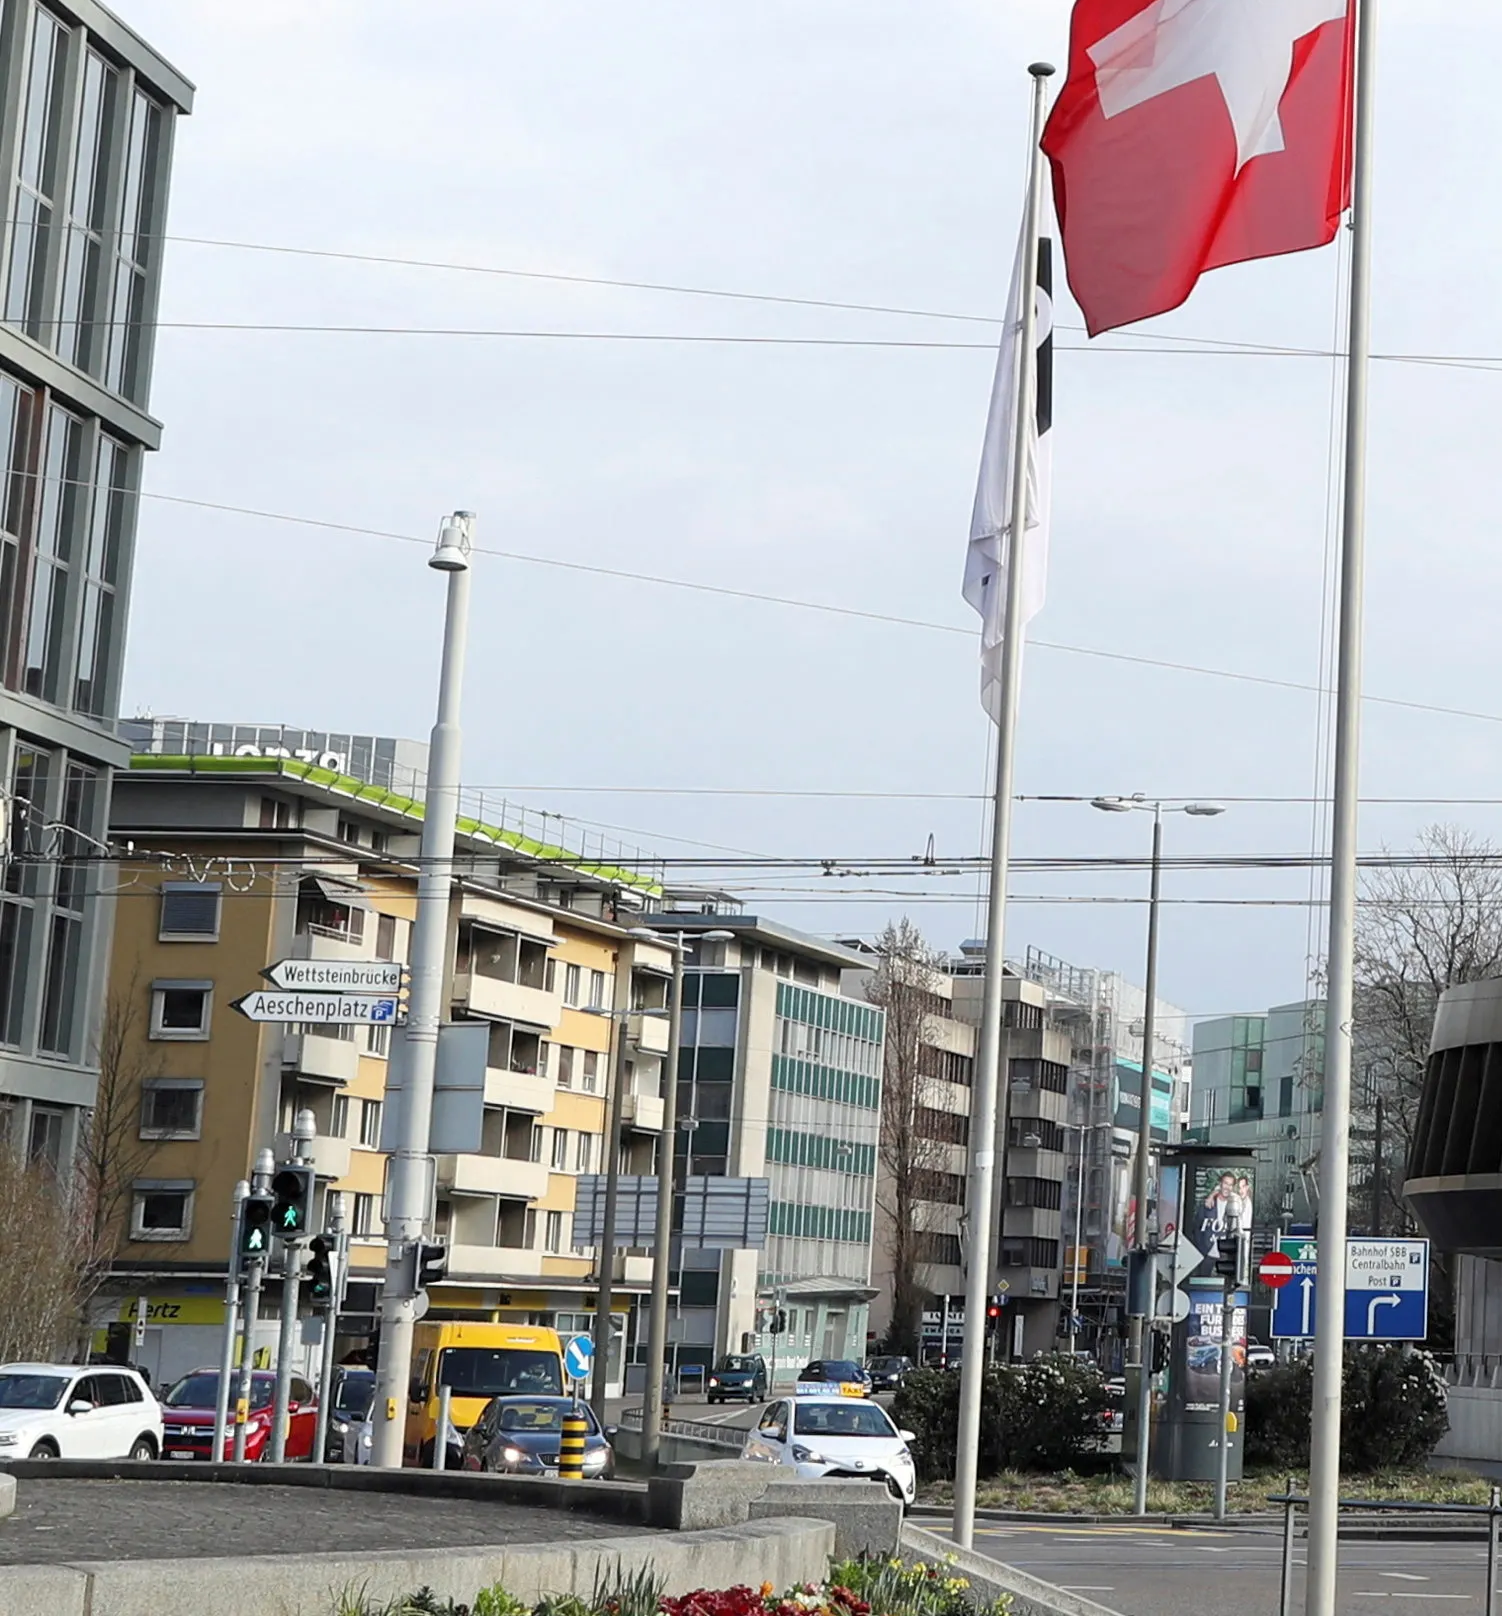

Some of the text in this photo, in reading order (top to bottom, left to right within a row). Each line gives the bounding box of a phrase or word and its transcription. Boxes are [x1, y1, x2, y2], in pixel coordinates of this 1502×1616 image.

[284, 965, 398, 985] Wettsteinbrücke
[253, 995, 368, 1021] Aeschenplatz
[1351, 1246, 1408, 1258] Bahnhof SBB
[1352, 1258, 1406, 1271] Centralbahn
[1368, 1275, 1387, 1287] Post
